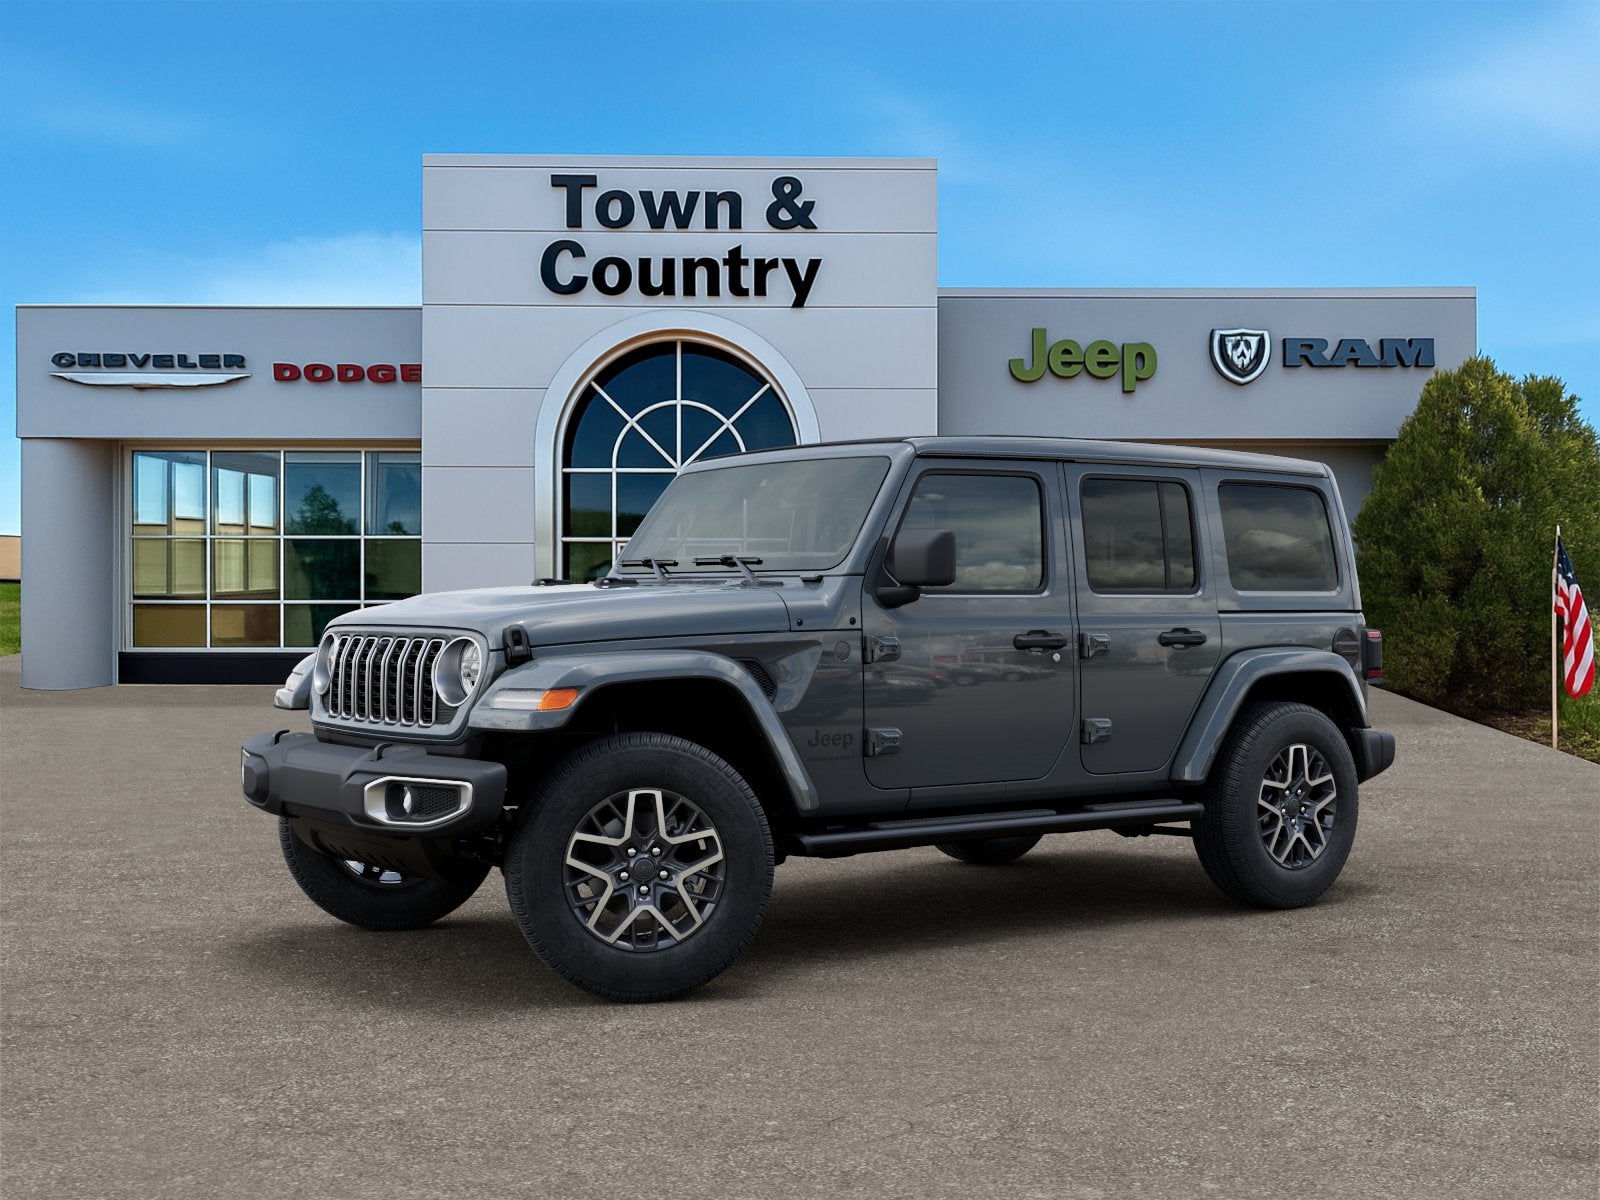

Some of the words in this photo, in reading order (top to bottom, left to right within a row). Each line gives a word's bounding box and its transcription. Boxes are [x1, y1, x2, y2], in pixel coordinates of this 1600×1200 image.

[551, 174, 742, 229] Town
[765, 176, 818, 230] &
[540, 239, 822, 308] Country
[272, 362, 421, 383] DODGE
[1009, 327, 1157, 393] Jeep
[1282, 337, 1435, 368] RAM
[808, 729, 854, 750] Jeep
